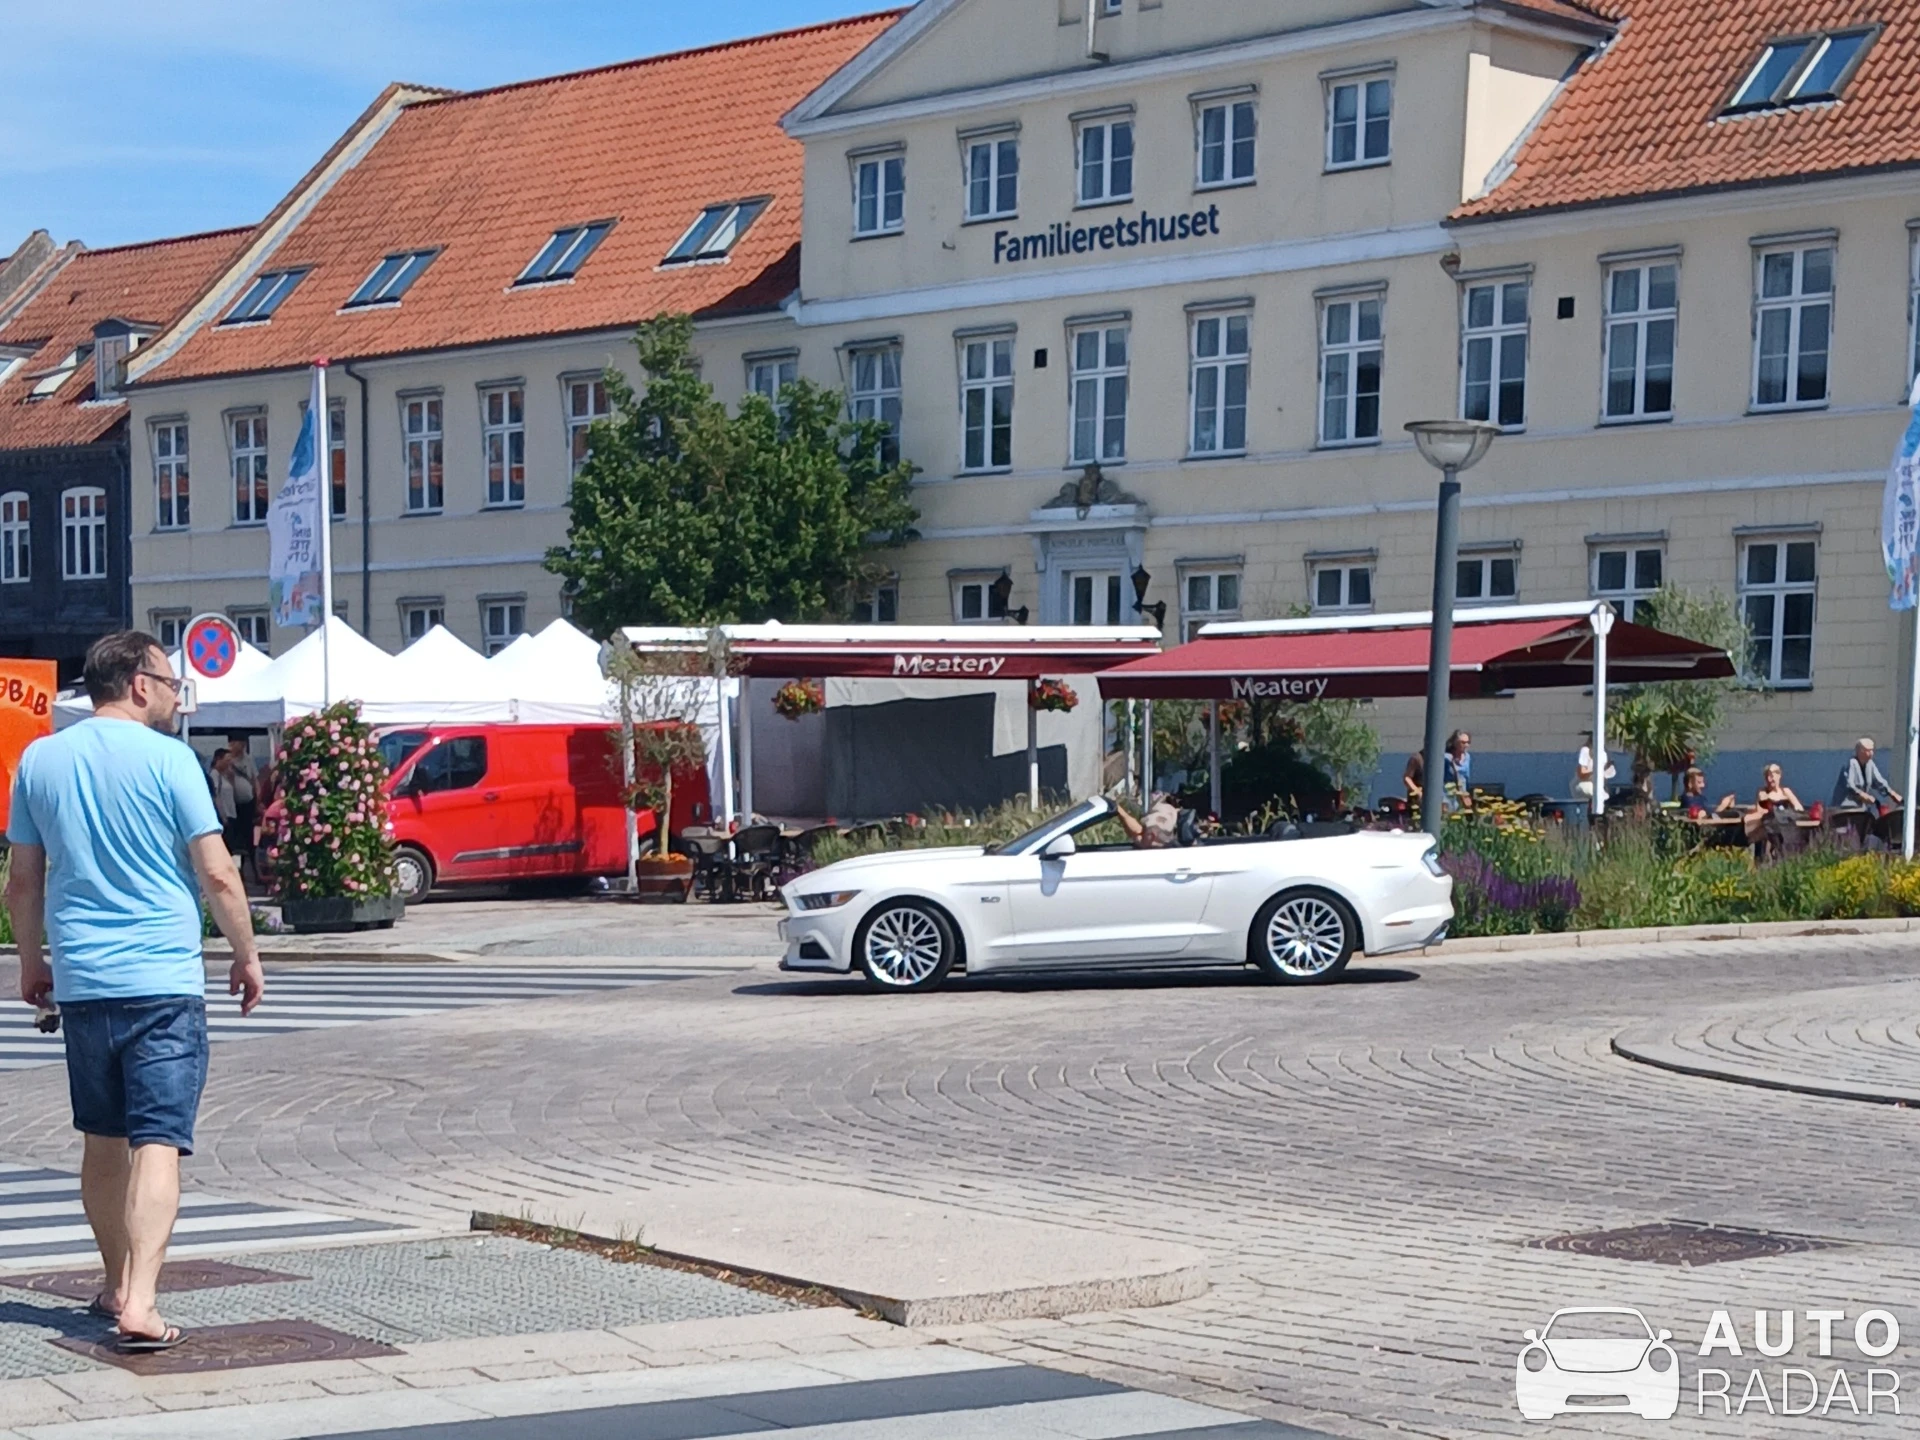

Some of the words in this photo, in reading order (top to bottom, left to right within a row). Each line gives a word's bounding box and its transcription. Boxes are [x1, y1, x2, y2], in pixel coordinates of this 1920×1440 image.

[994, 204, 1220, 264] Familieretshuset
[893, 654, 1005, 675] Meatery
[1231, 677, 1328, 699] Meatery
